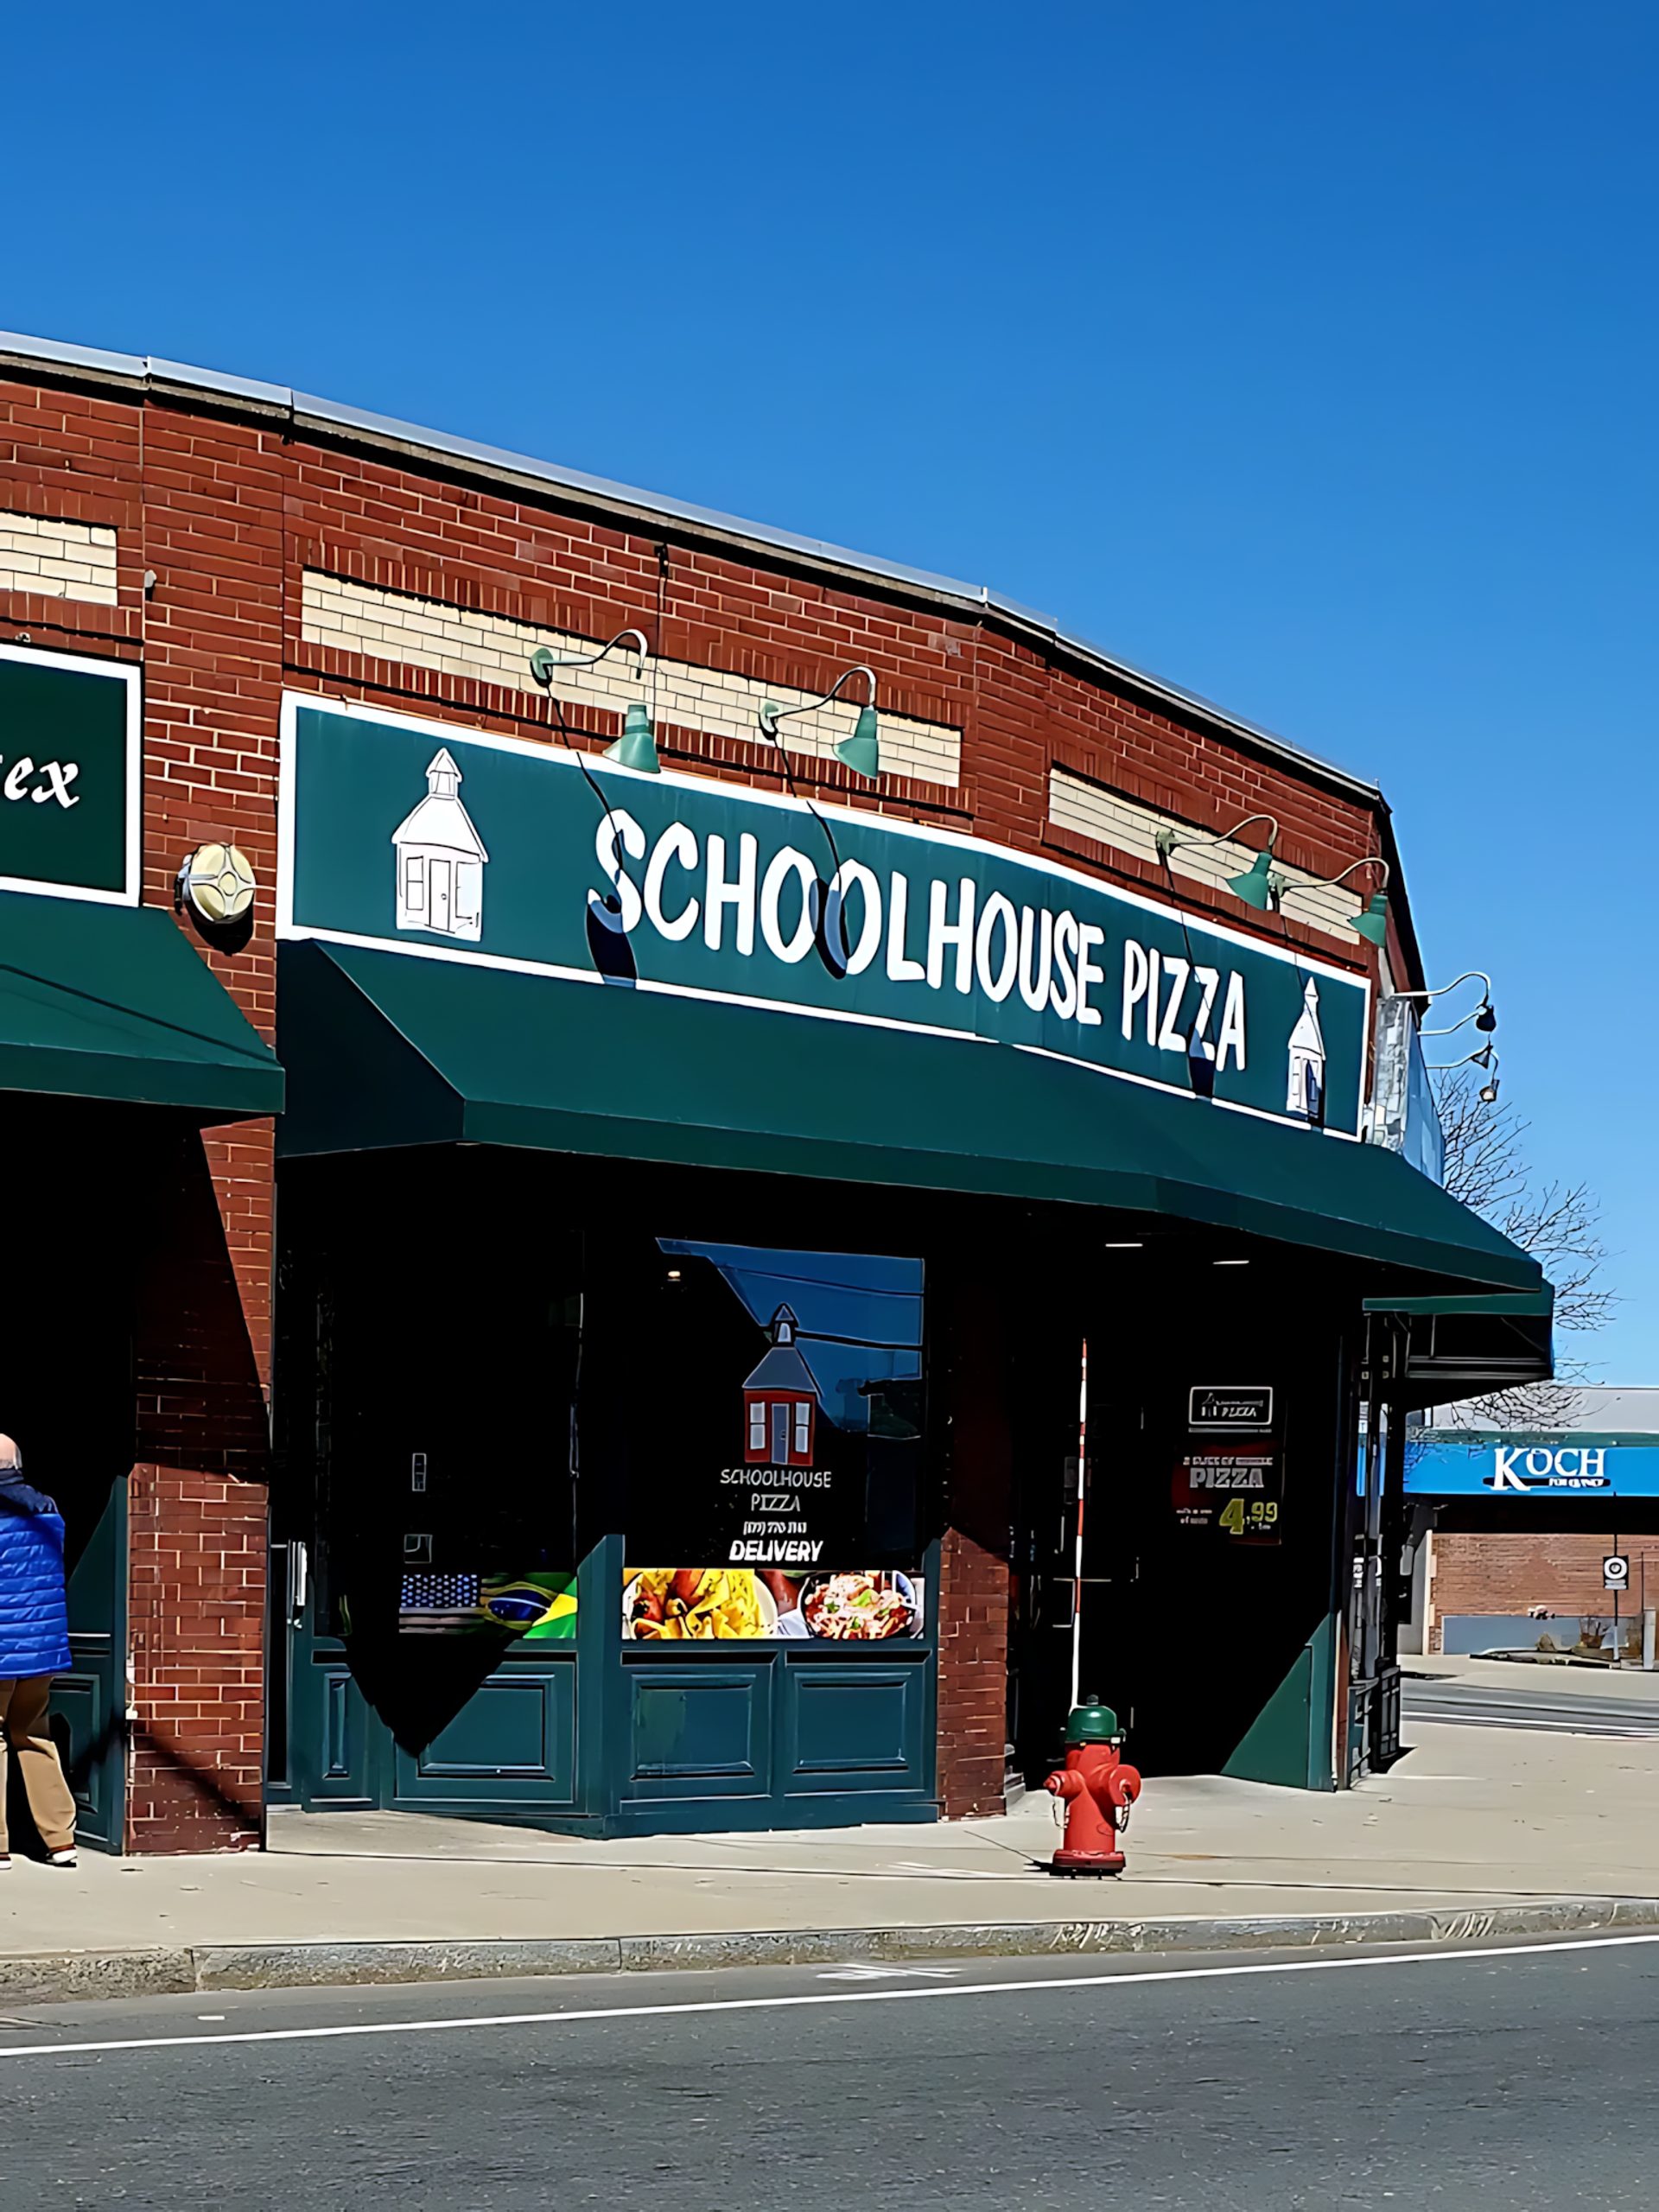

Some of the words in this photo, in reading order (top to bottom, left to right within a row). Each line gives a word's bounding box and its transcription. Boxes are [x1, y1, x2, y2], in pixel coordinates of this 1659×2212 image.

[0, 754, 80, 808] ex
[587, 809, 1103, 1027] SCHOOLHOUSE
[1122, 938, 1247, 1072] PIZZA
[720, 1468, 832, 1489] SCHOOLHOUSE
[1189, 1467, 1265, 1488] PIZZA
[1491, 1447, 1607, 1491] KOCH
[750, 1492, 801, 1512] PIZZA
[728, 1539, 824, 1562] DELIVERY
